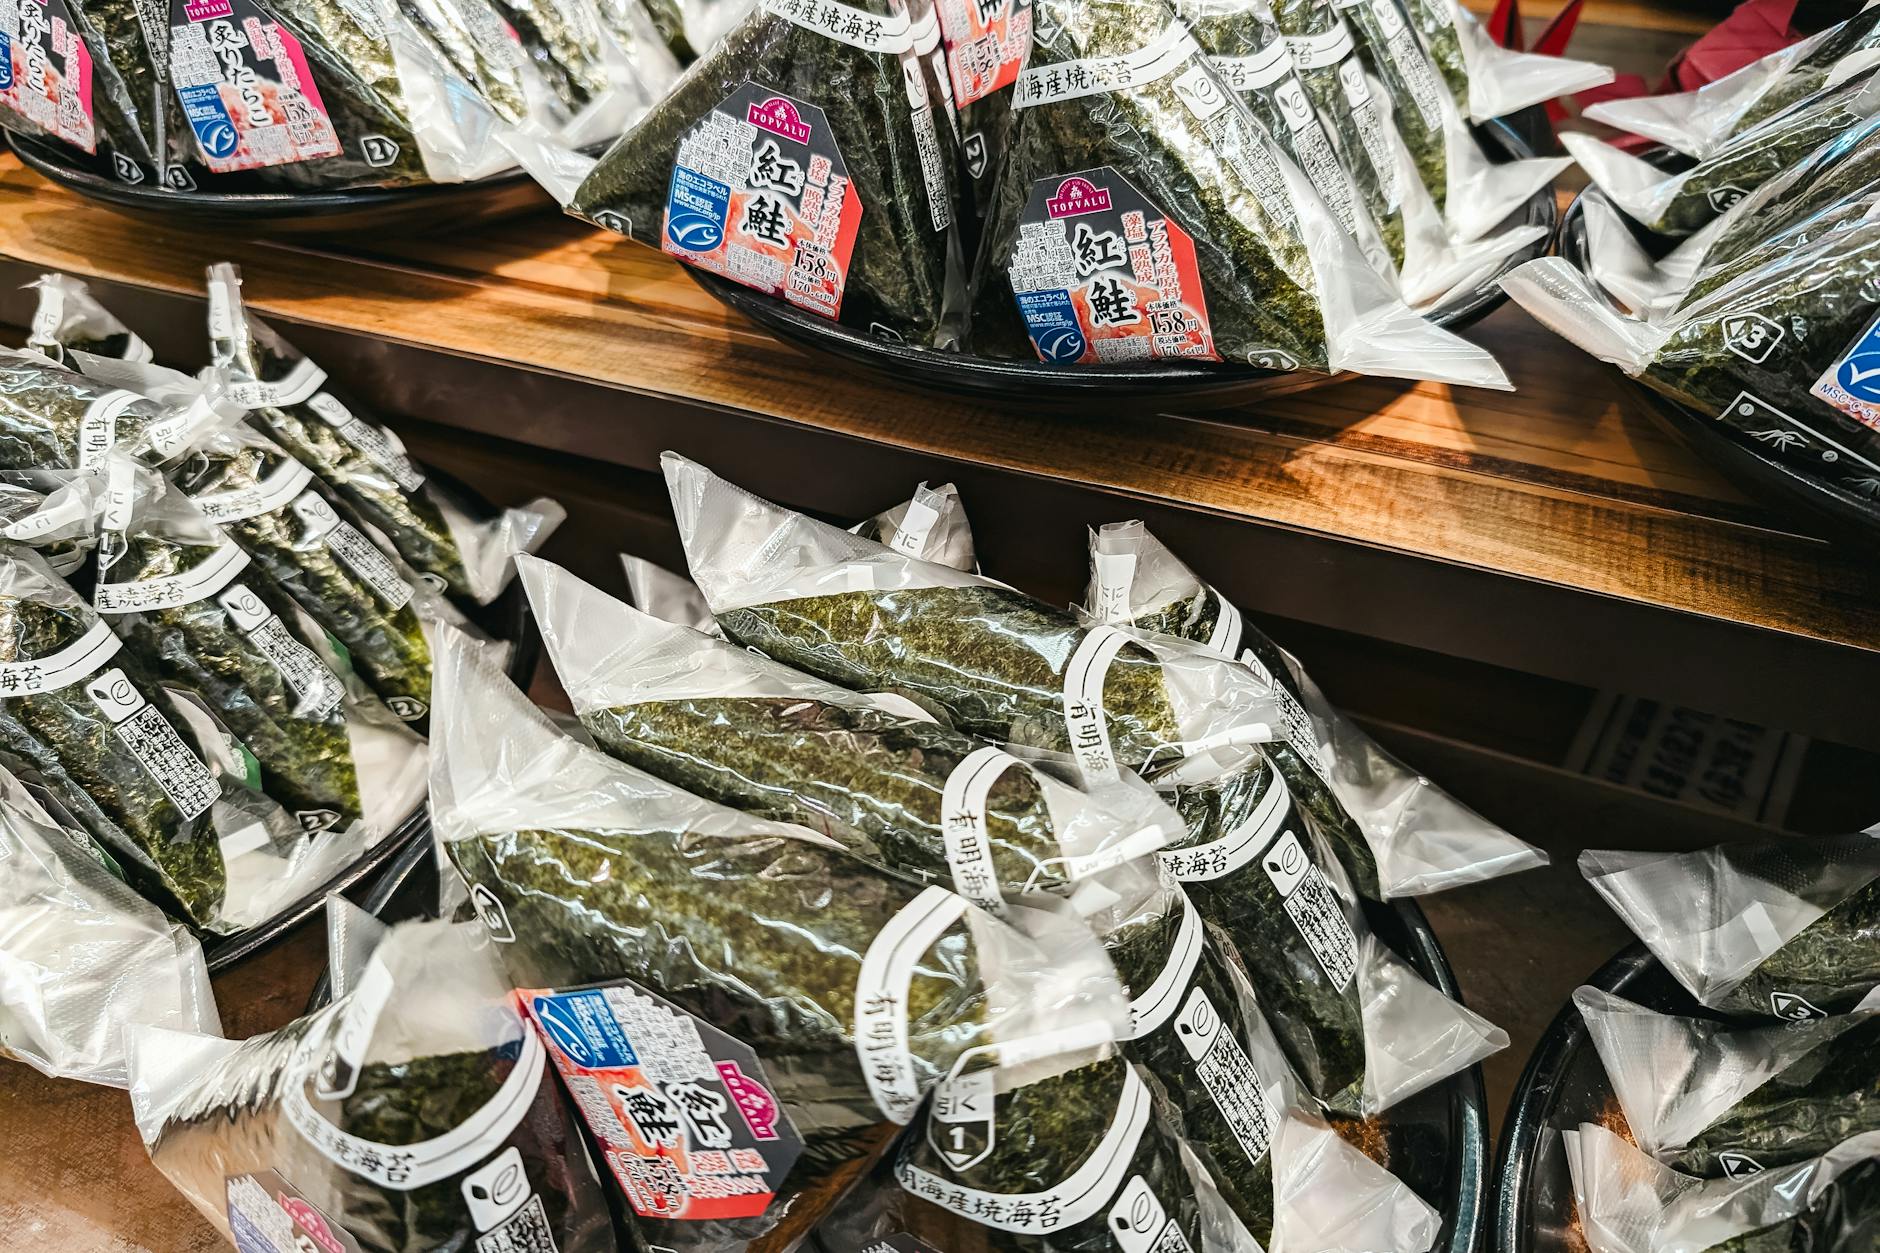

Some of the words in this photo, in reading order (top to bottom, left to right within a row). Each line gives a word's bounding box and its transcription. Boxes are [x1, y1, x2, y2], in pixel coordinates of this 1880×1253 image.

[188, 3, 228, 17] TOPVALU
[214, 26, 269, 123] 炙りたらこ
[753, 110, 806, 138] TOPVALU
[370, 140, 385, 160] 2
[966, 143, 980, 160] 2
[678, 170, 728, 196] 海のエコラベル
[742, 144, 797, 247] 紅鮭
[674, 189, 714, 212] MSC認証
[816, 175, 847, 249] アラスカ産原料
[1052, 195, 1106, 213] TOPVALU
[792, 248, 836, 283] 158円
[1149, 220, 1180, 300] アラスカ産原料
[1075, 227, 1138, 325] 紅鮭
[1026, 311, 1064, 324] MSC認証
[1148, 310, 1198, 335] 158円
[1741, 324, 1767, 350] 3
[395, 702, 413, 716] 2
[304, 815, 323, 830] 2
[721, 1063, 770, 1136] TOPVALU
[949, 1126, 965, 1150] 1
